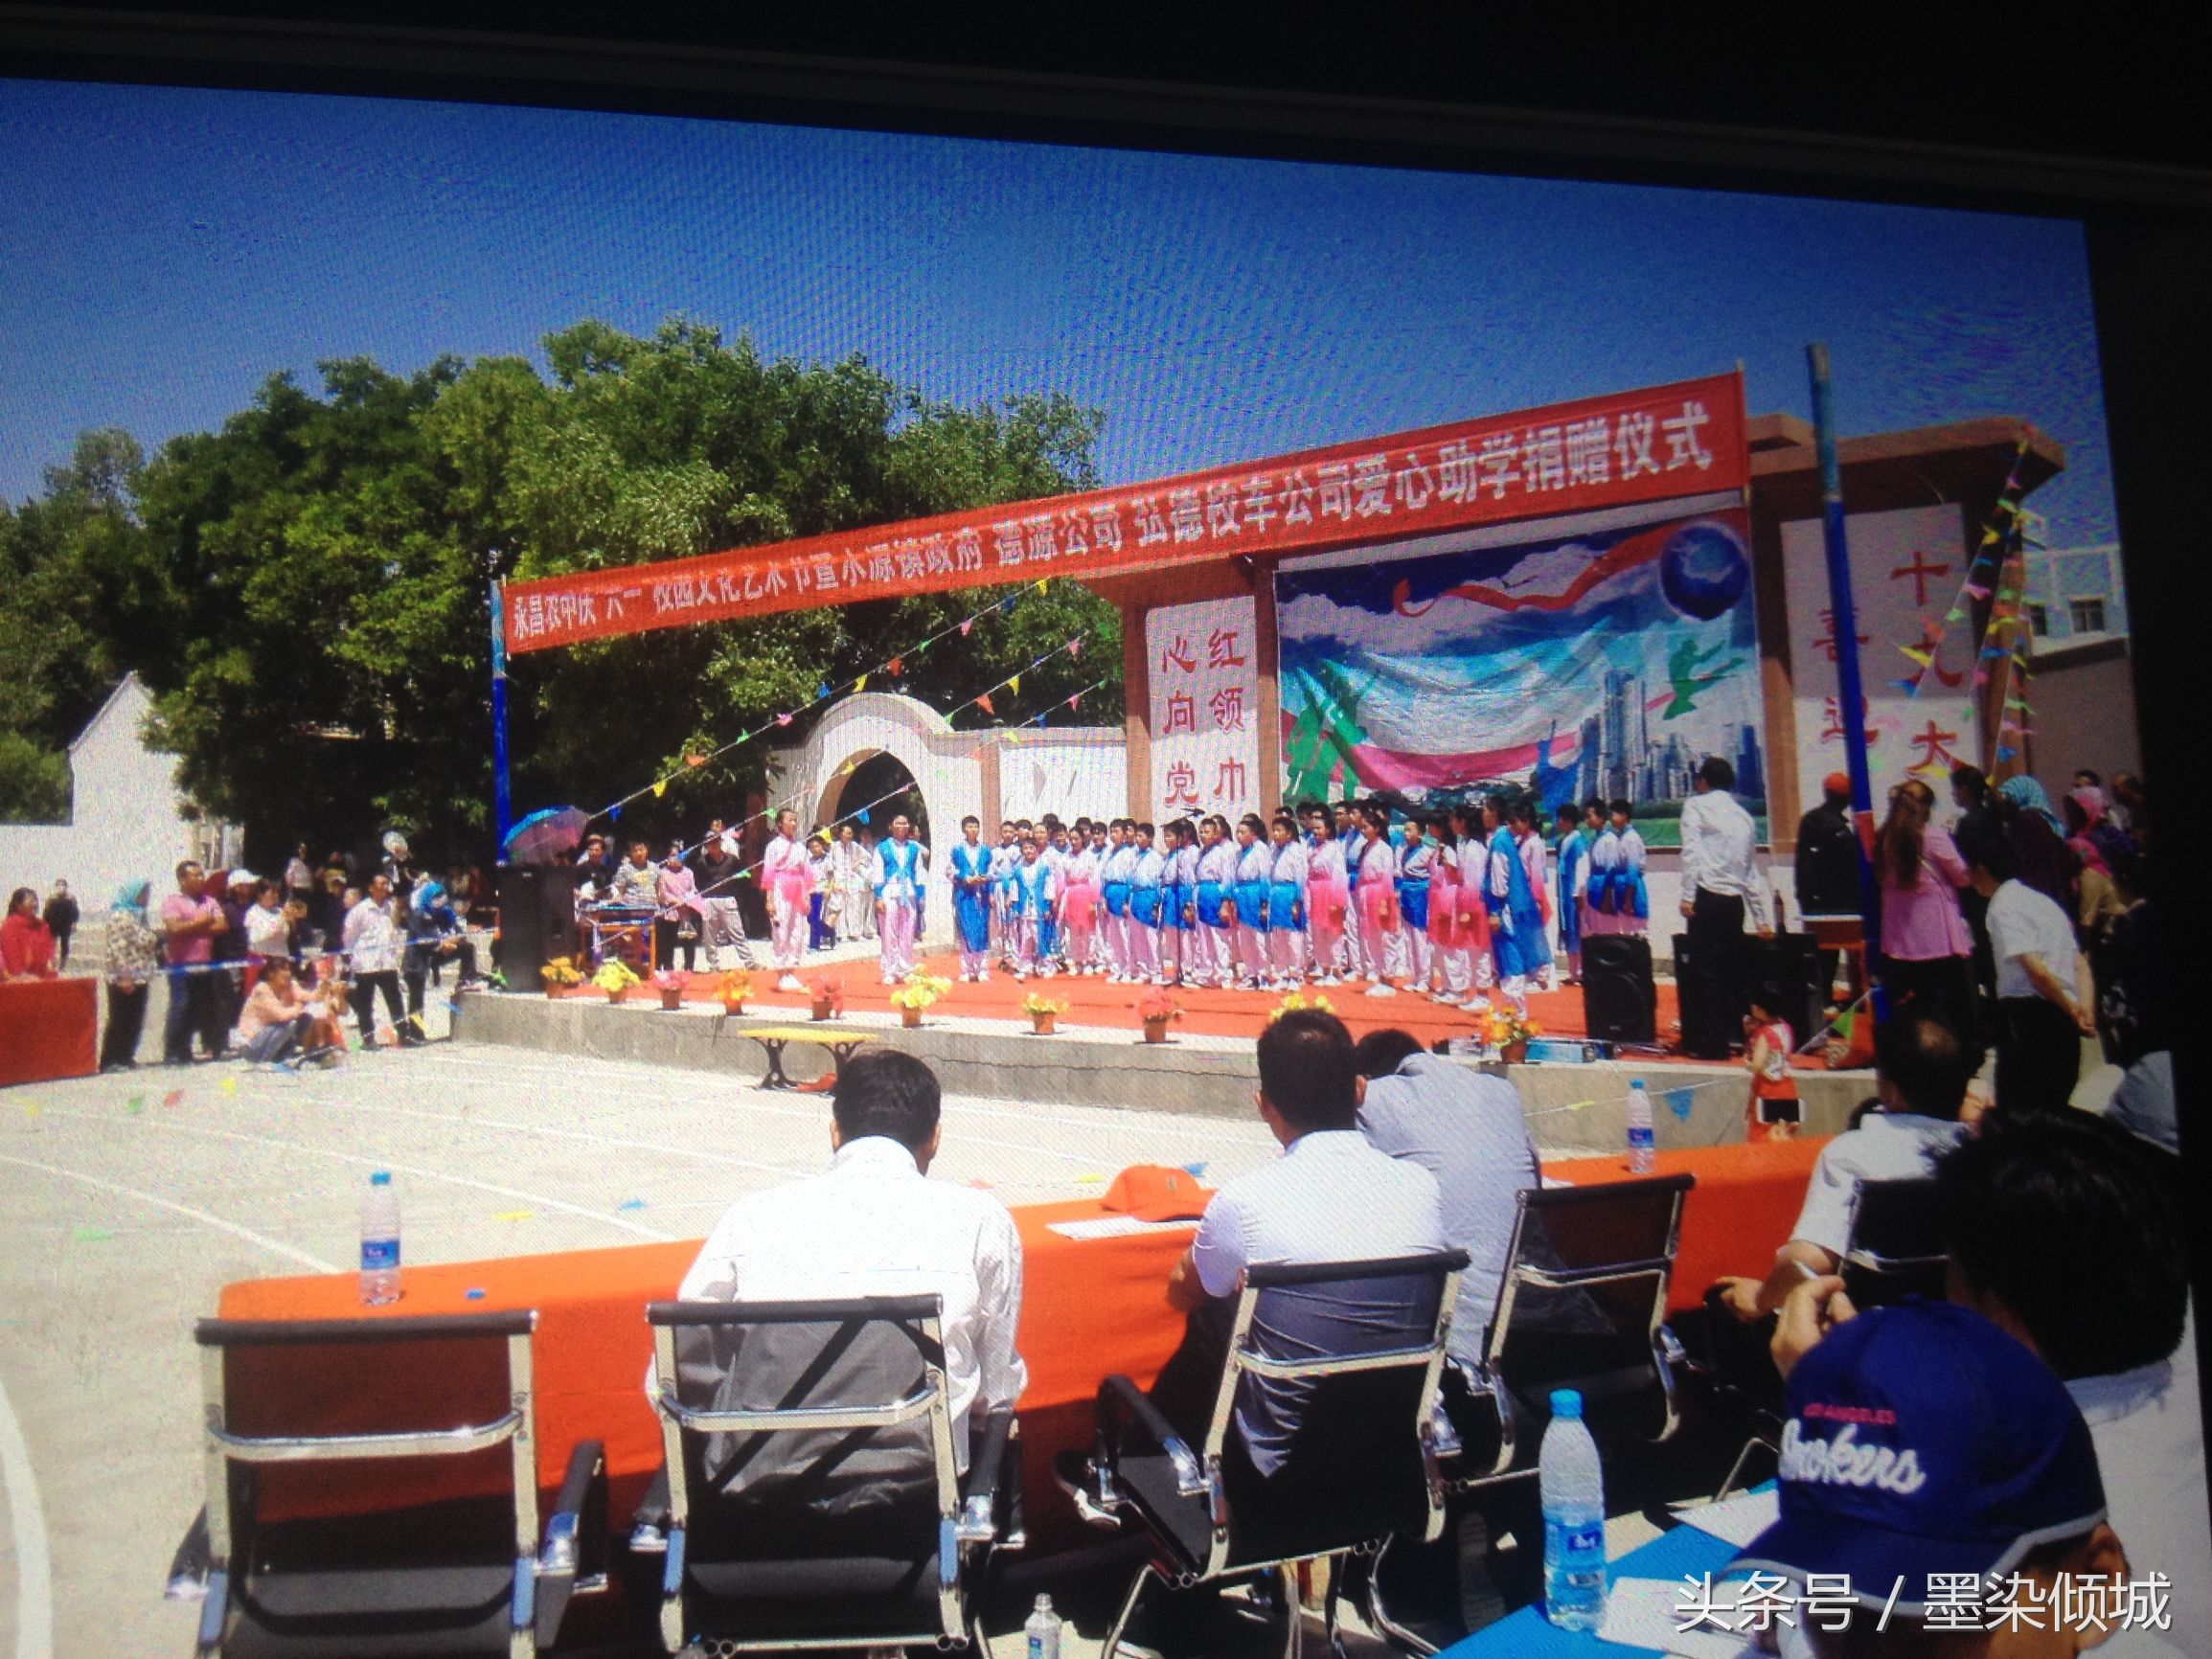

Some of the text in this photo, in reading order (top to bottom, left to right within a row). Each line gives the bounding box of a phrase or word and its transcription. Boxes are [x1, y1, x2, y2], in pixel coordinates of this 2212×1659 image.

[1160, 634, 1200, 807] 心向党
[1207, 627, 1246, 803] 红领巾
